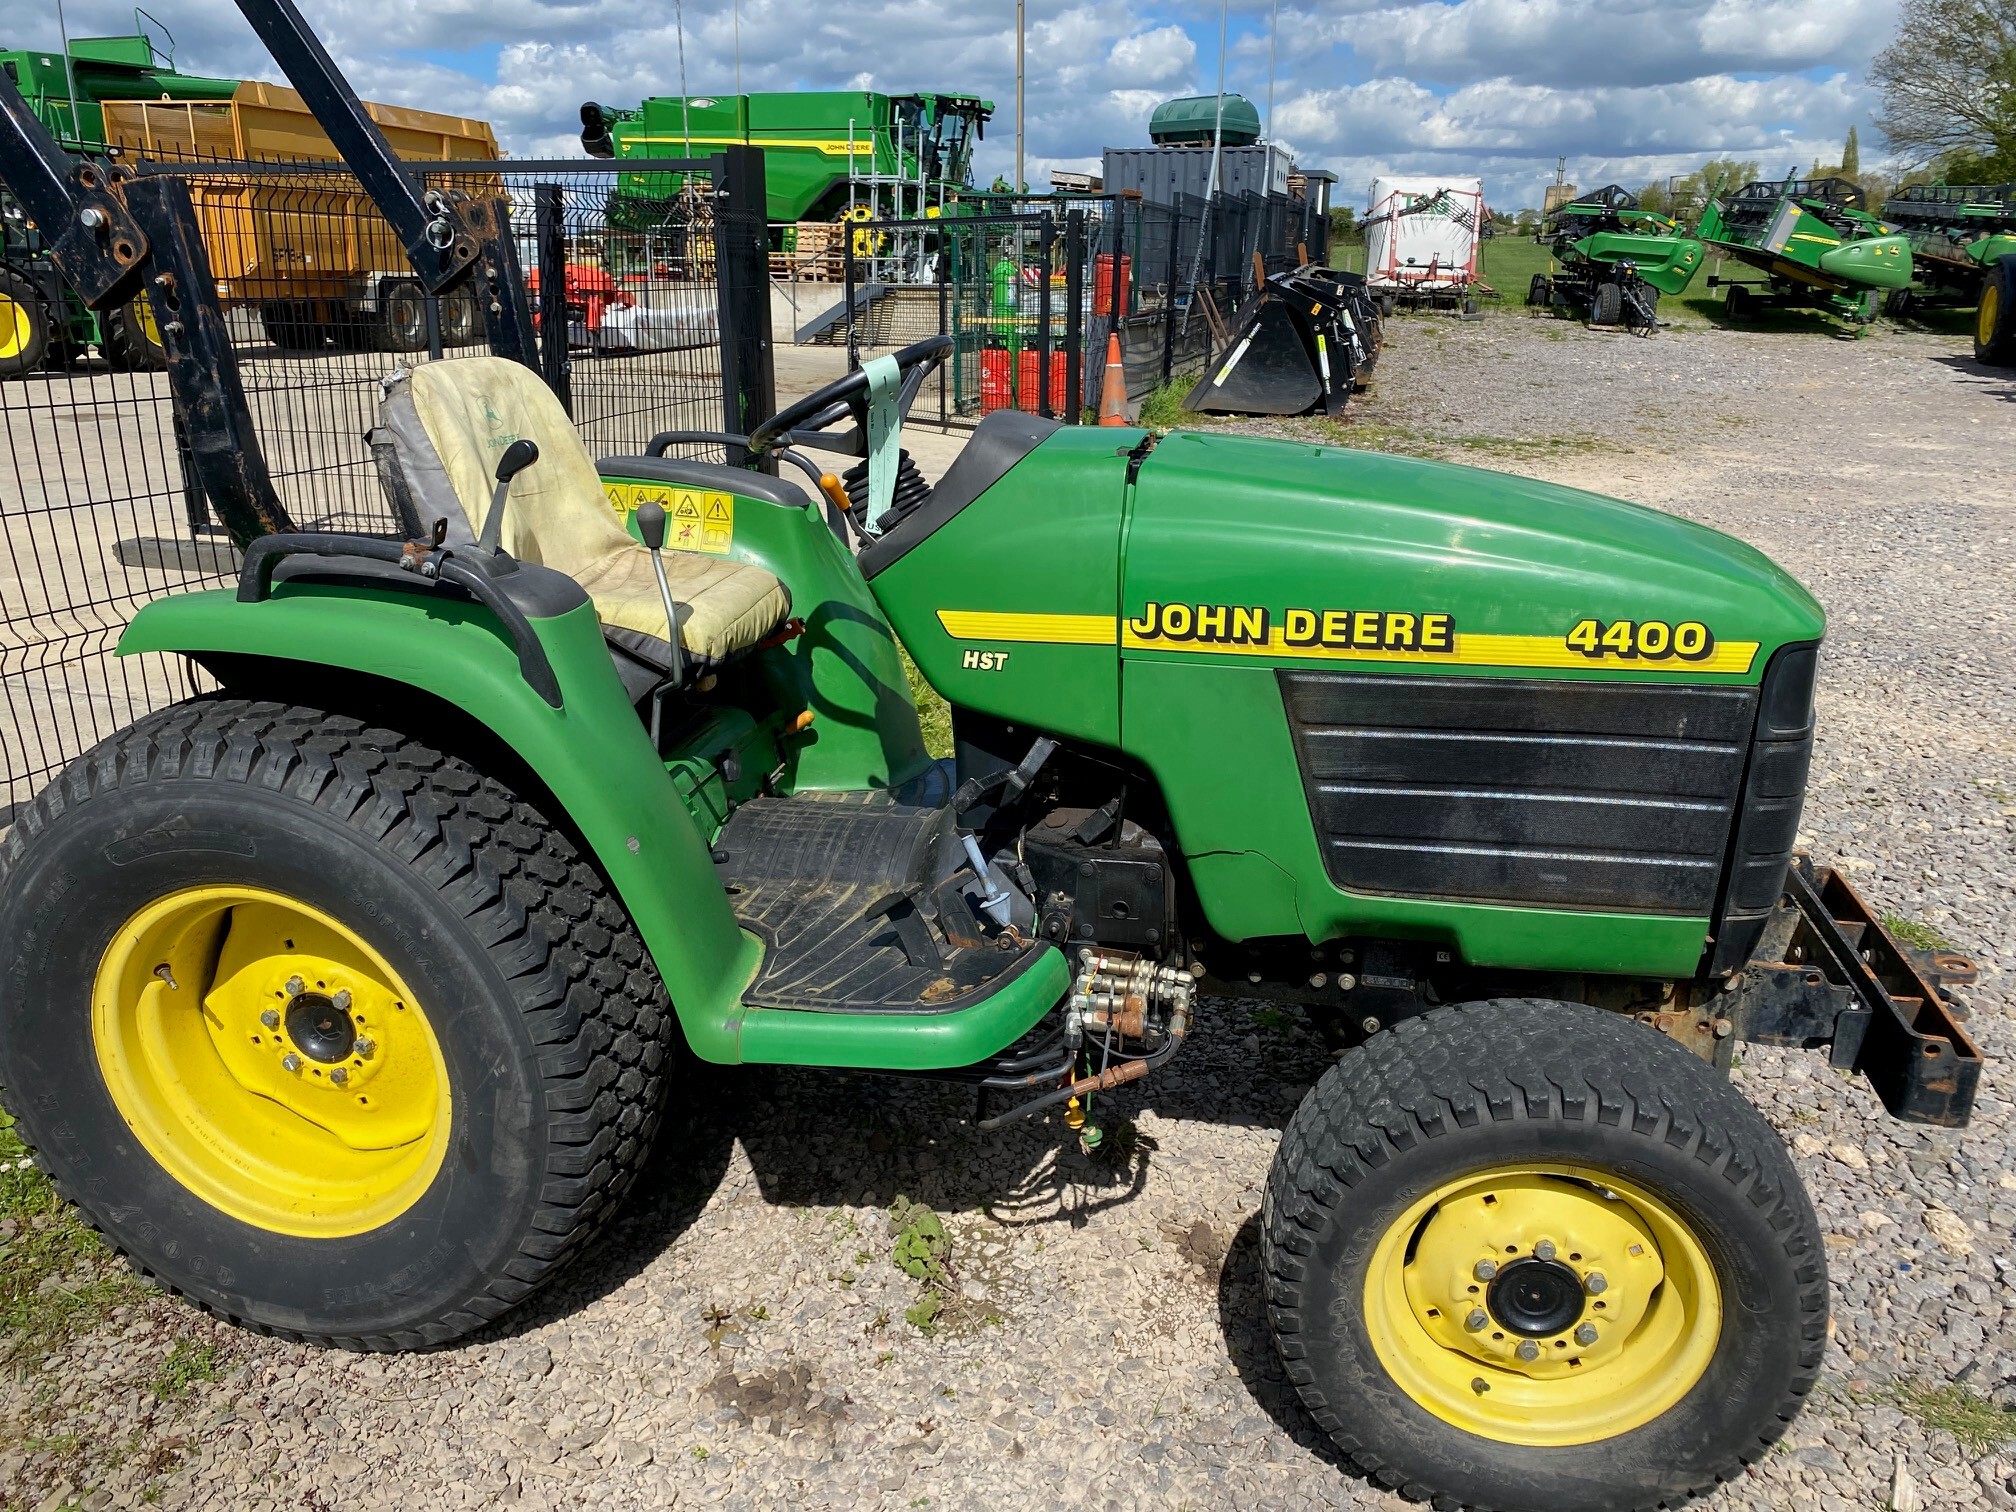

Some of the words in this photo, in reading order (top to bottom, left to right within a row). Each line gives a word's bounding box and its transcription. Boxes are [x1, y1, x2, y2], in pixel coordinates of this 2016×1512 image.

[826, 143, 845, 151] JOHN
[846, 143, 870, 151] DEERE
[1130, 602, 1269, 645] JOHN
[1284, 608, 1454, 652] DEERE
[1565, 618, 1715, 662] 4400
[961, 650, 1009, 672] HST
[37, 1092, 236, 1288] GOODYEAR
